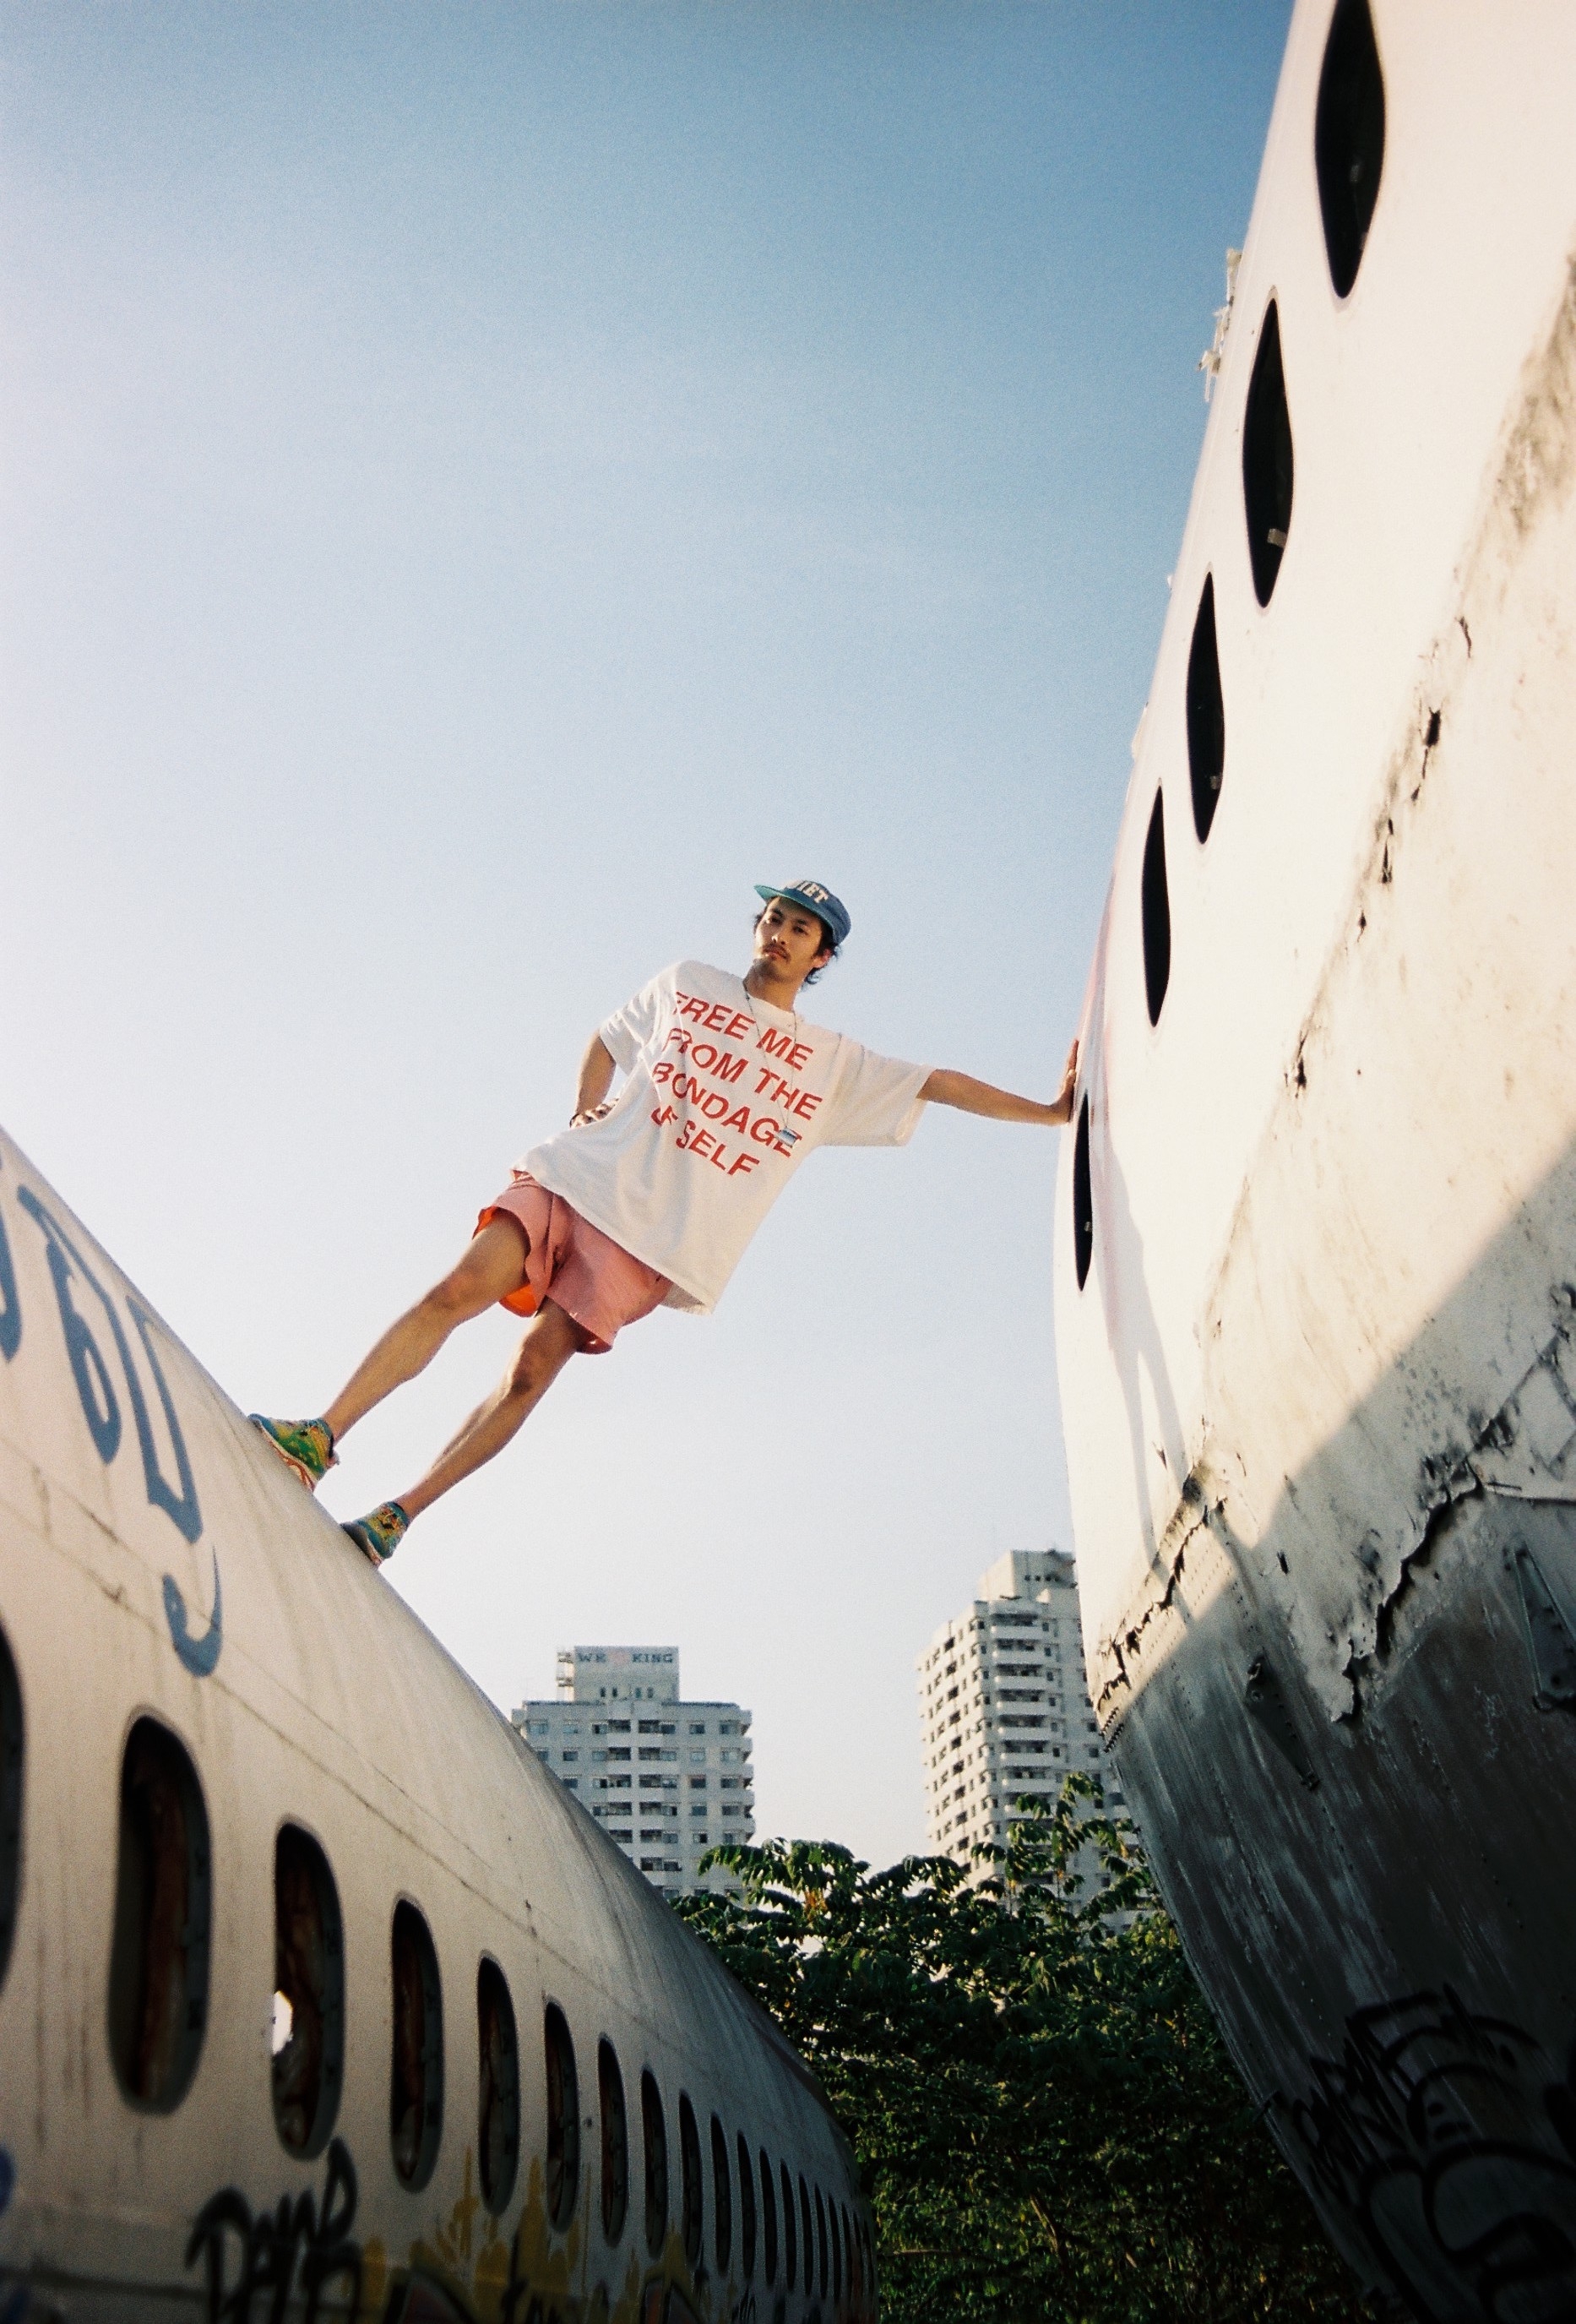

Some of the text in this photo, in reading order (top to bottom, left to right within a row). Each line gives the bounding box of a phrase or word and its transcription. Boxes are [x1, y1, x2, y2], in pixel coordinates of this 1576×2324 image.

[756, 1027, 813, 1071] ME
[754, 1067, 823, 1121] THE
[676, 1119, 760, 1176] SELF
[632, 1652, 673, 1663] KING
